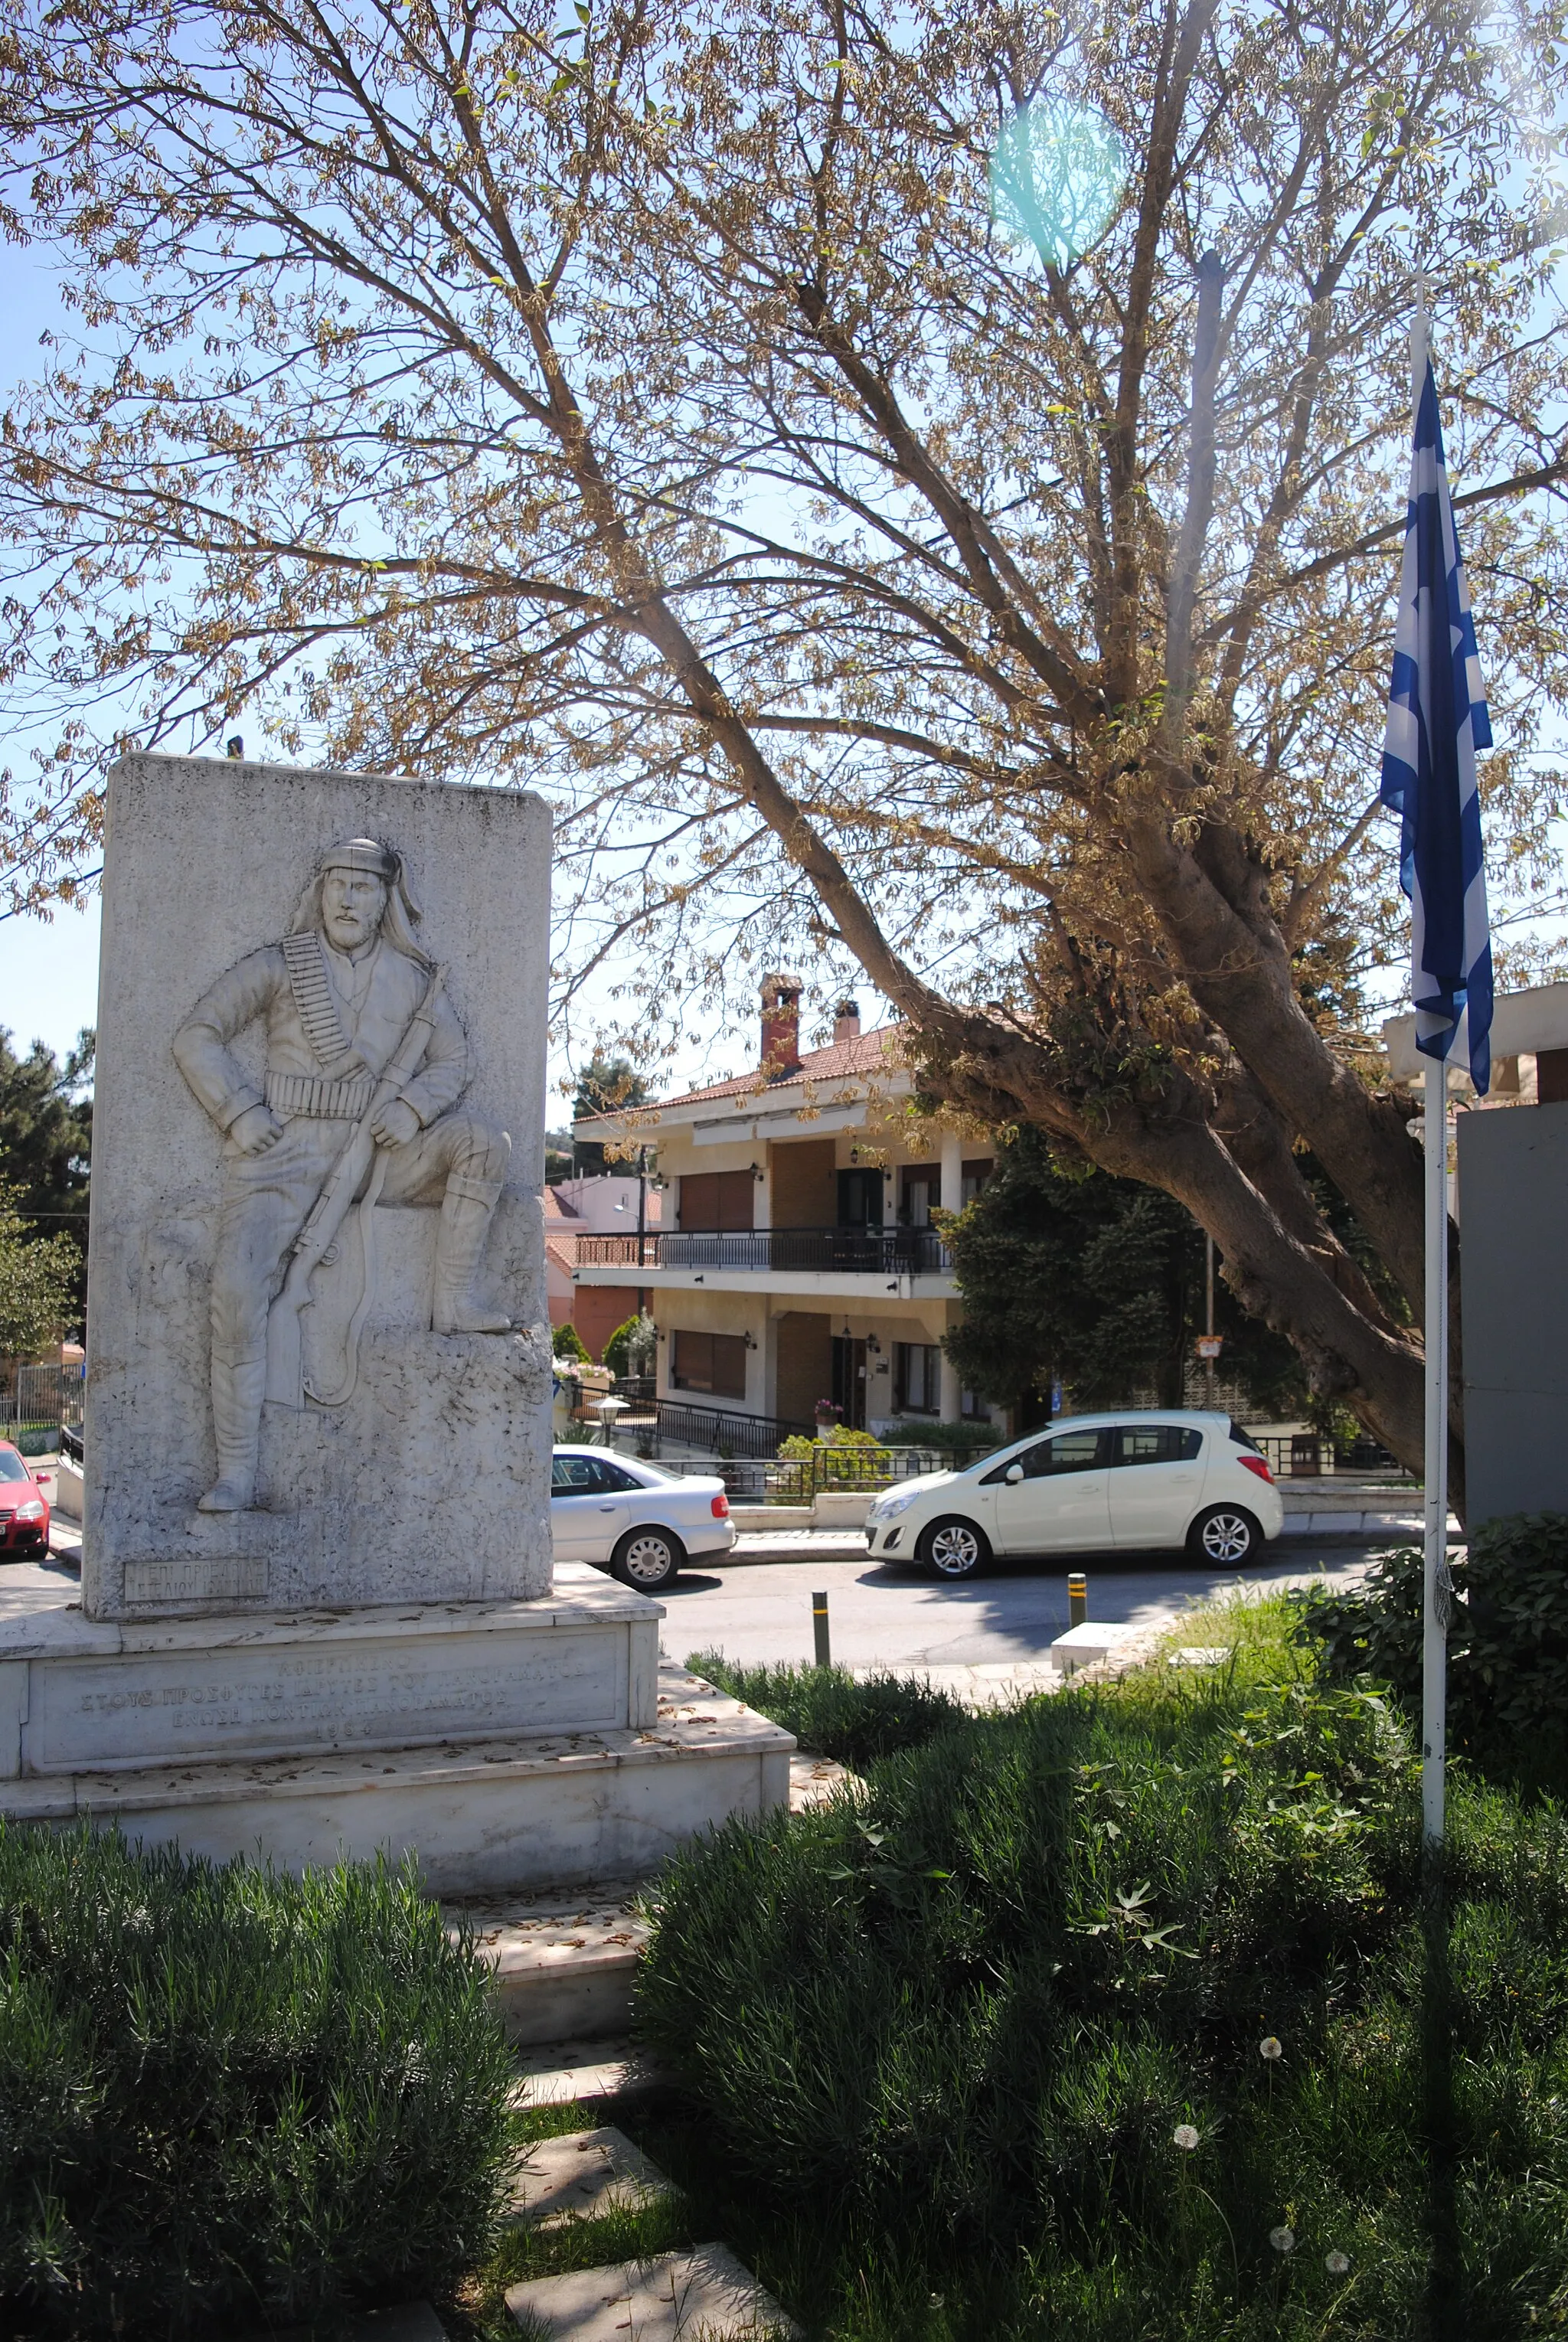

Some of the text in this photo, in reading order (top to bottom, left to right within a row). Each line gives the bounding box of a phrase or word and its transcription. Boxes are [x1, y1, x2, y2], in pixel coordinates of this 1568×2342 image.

[279, 1655, 410, 1677] ΑΦΙΕΡΩΜΕΝΟ
[81, 1662, 584, 1710] ΣΤΟΥΣ ΠΡΟΣΦΥΓΕΣ ΙΔΡΥΤΕΣ ΤΟΥ ΠΑΝΟΡΑΜΑΤΟΣ
[173, 1690, 506, 1727] ΕΝΩΣΗ ΠΟΝΤΙΩΝ ΠΑΝΟΡΑΜΑΤΟΣ
[315, 1723, 372, 1739] 1984
